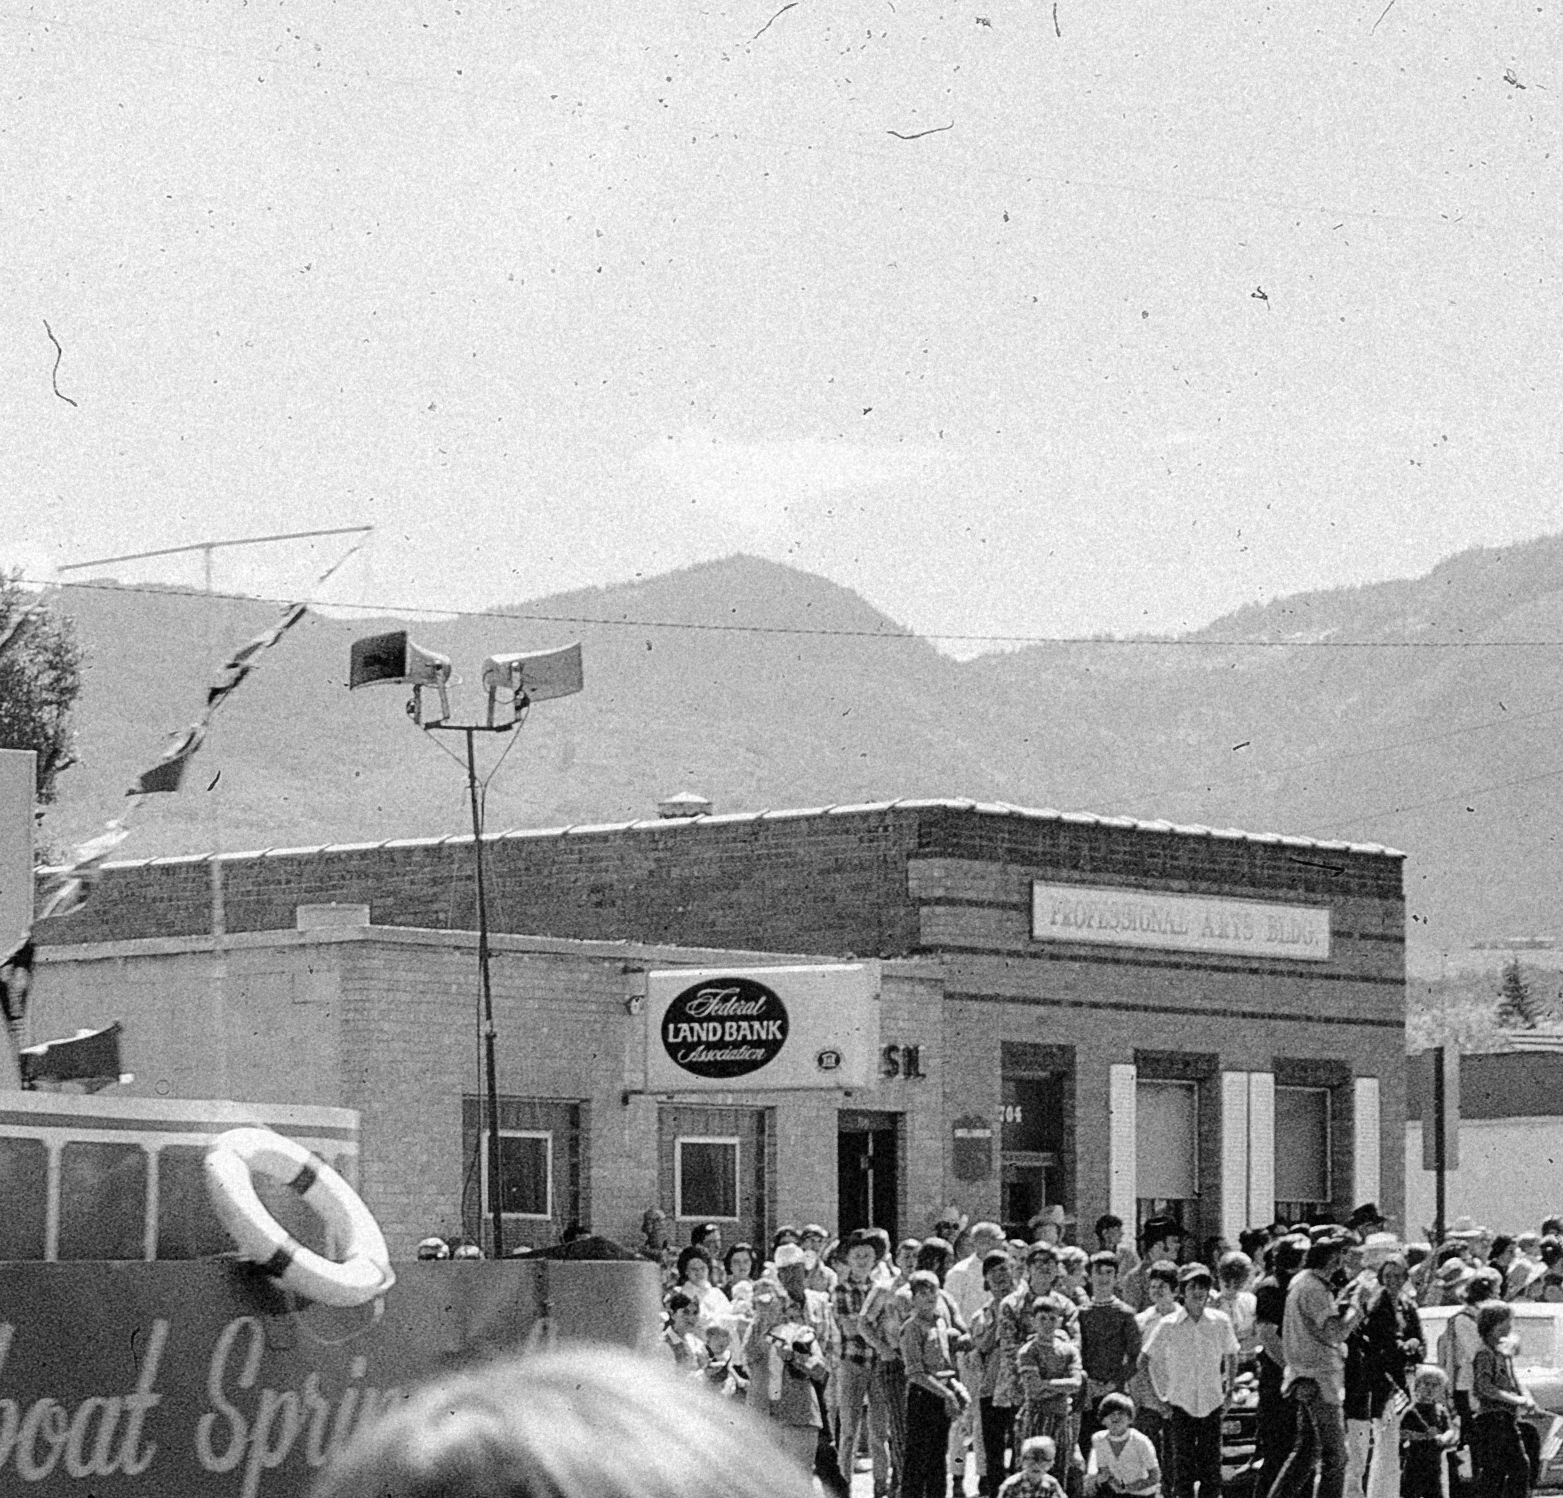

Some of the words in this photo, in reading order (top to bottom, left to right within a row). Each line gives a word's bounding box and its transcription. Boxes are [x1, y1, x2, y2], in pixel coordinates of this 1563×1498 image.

[1049, 898, 1188, 935] PROFESSIONAL
[685, 987, 767, 1018] Federal
[667, 1021, 723, 1043] LAND
[723, 1019, 784, 1042] BANK
[677, 1044, 767, 1064] Association
